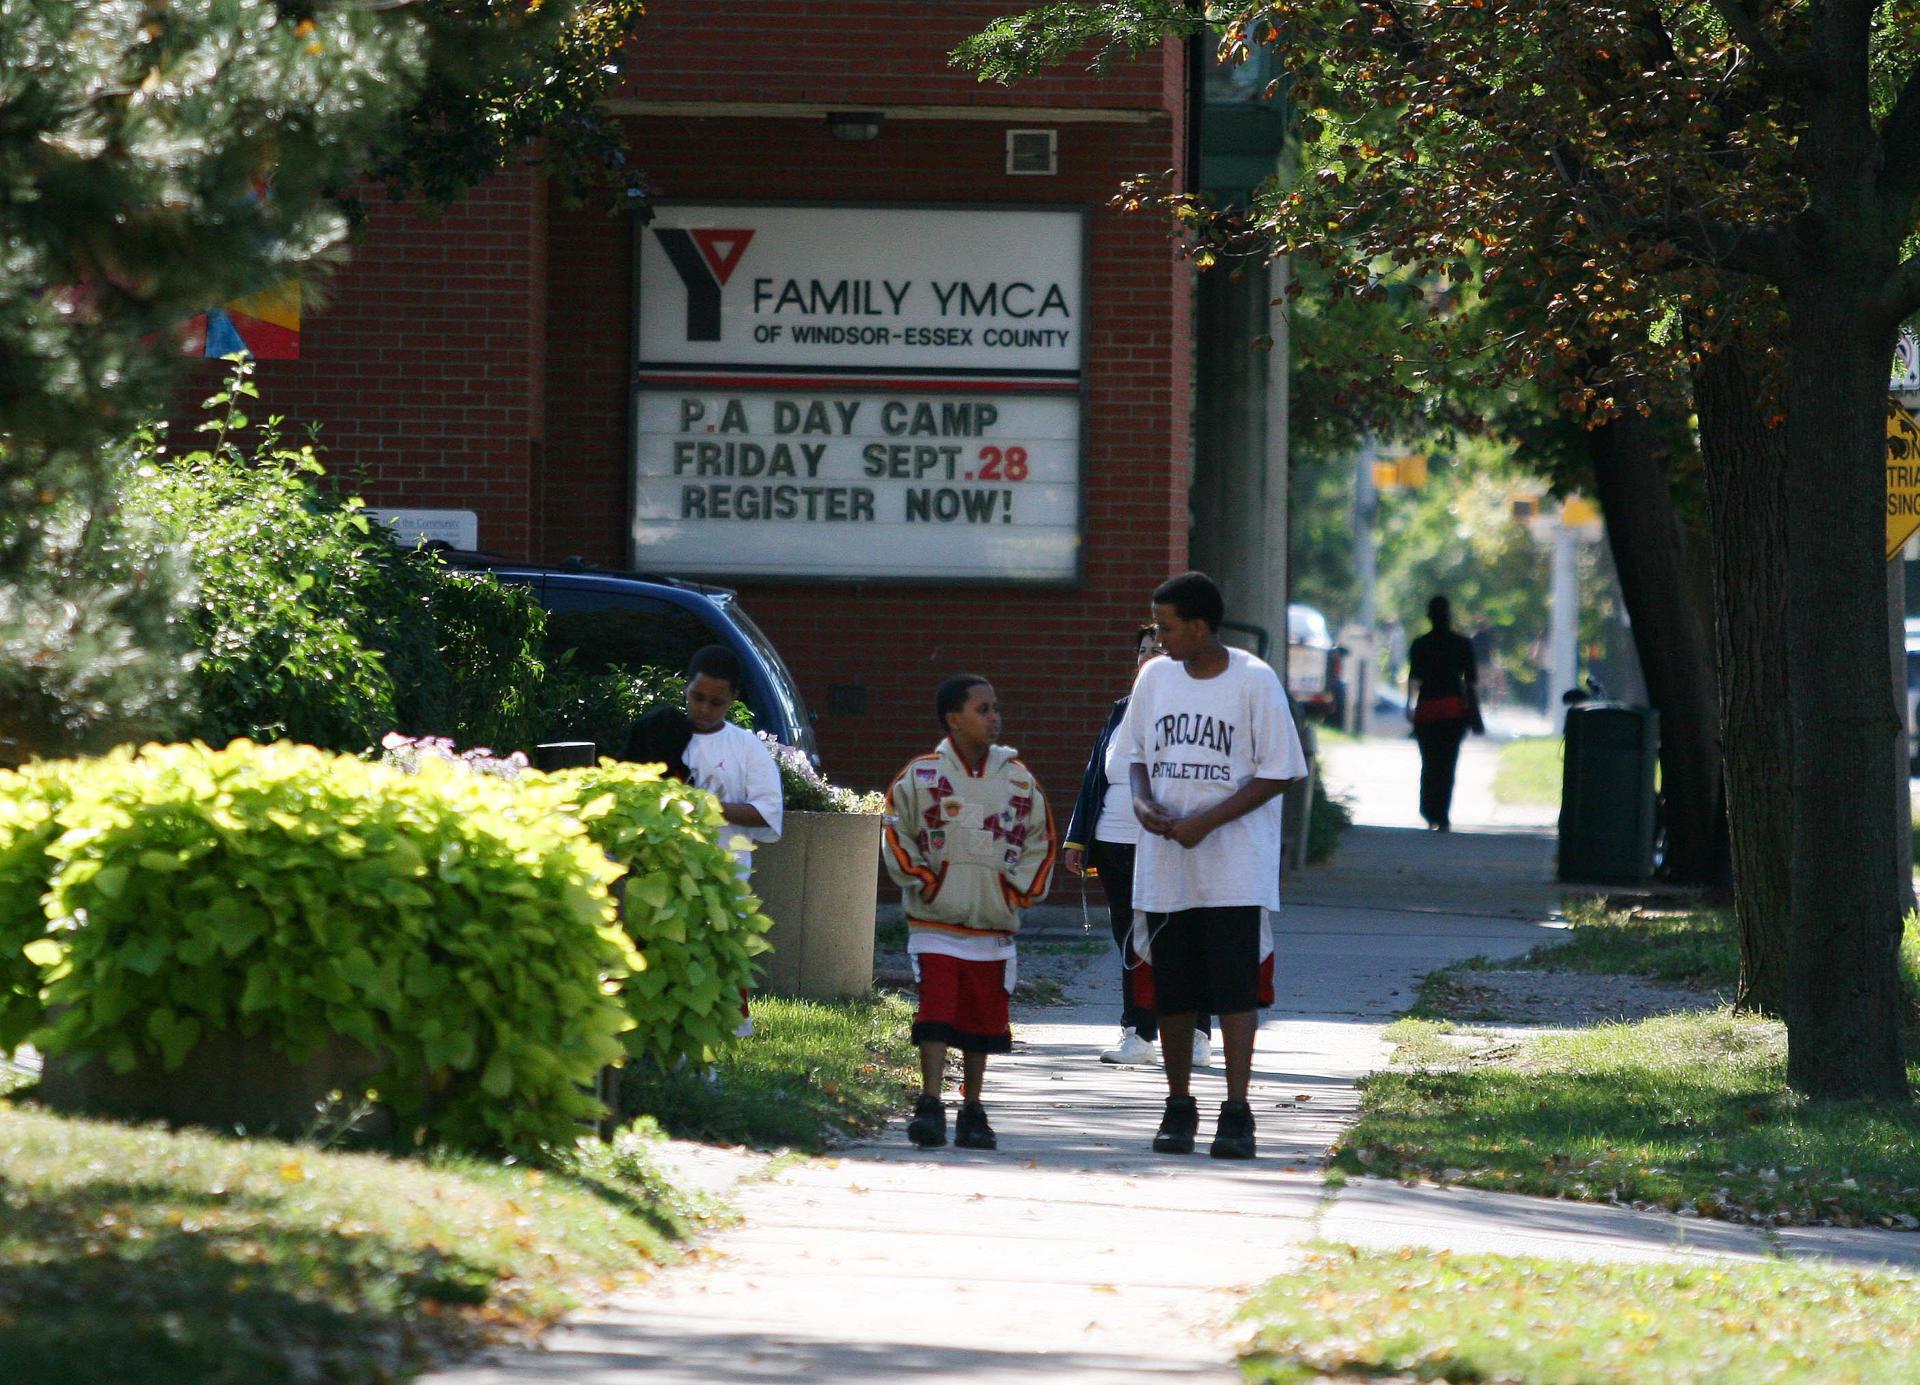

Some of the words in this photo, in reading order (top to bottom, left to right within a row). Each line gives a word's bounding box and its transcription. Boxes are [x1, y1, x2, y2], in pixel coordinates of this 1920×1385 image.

[754, 278, 912, 316] FAMILY
[931, 281, 1070, 319] YMCA
[754, 325, 783, 344] OF
[791, 325, 973, 346] WINDSOR-ESSEX
[983, 329, 1070, 348] COUNTY
[680, 398, 750, 434] P.A
[773, 400, 861, 436] DAY
[880, 402, 998, 437] CAMP
[672, 441, 827, 478] FRIDAY
[681, 484, 875, 522] REGISTER
[905, 487, 1013, 524] NOW!
[1155, 713, 1235, 757] TROJAN
[1151, 761, 1231, 781] ATHLETICS
